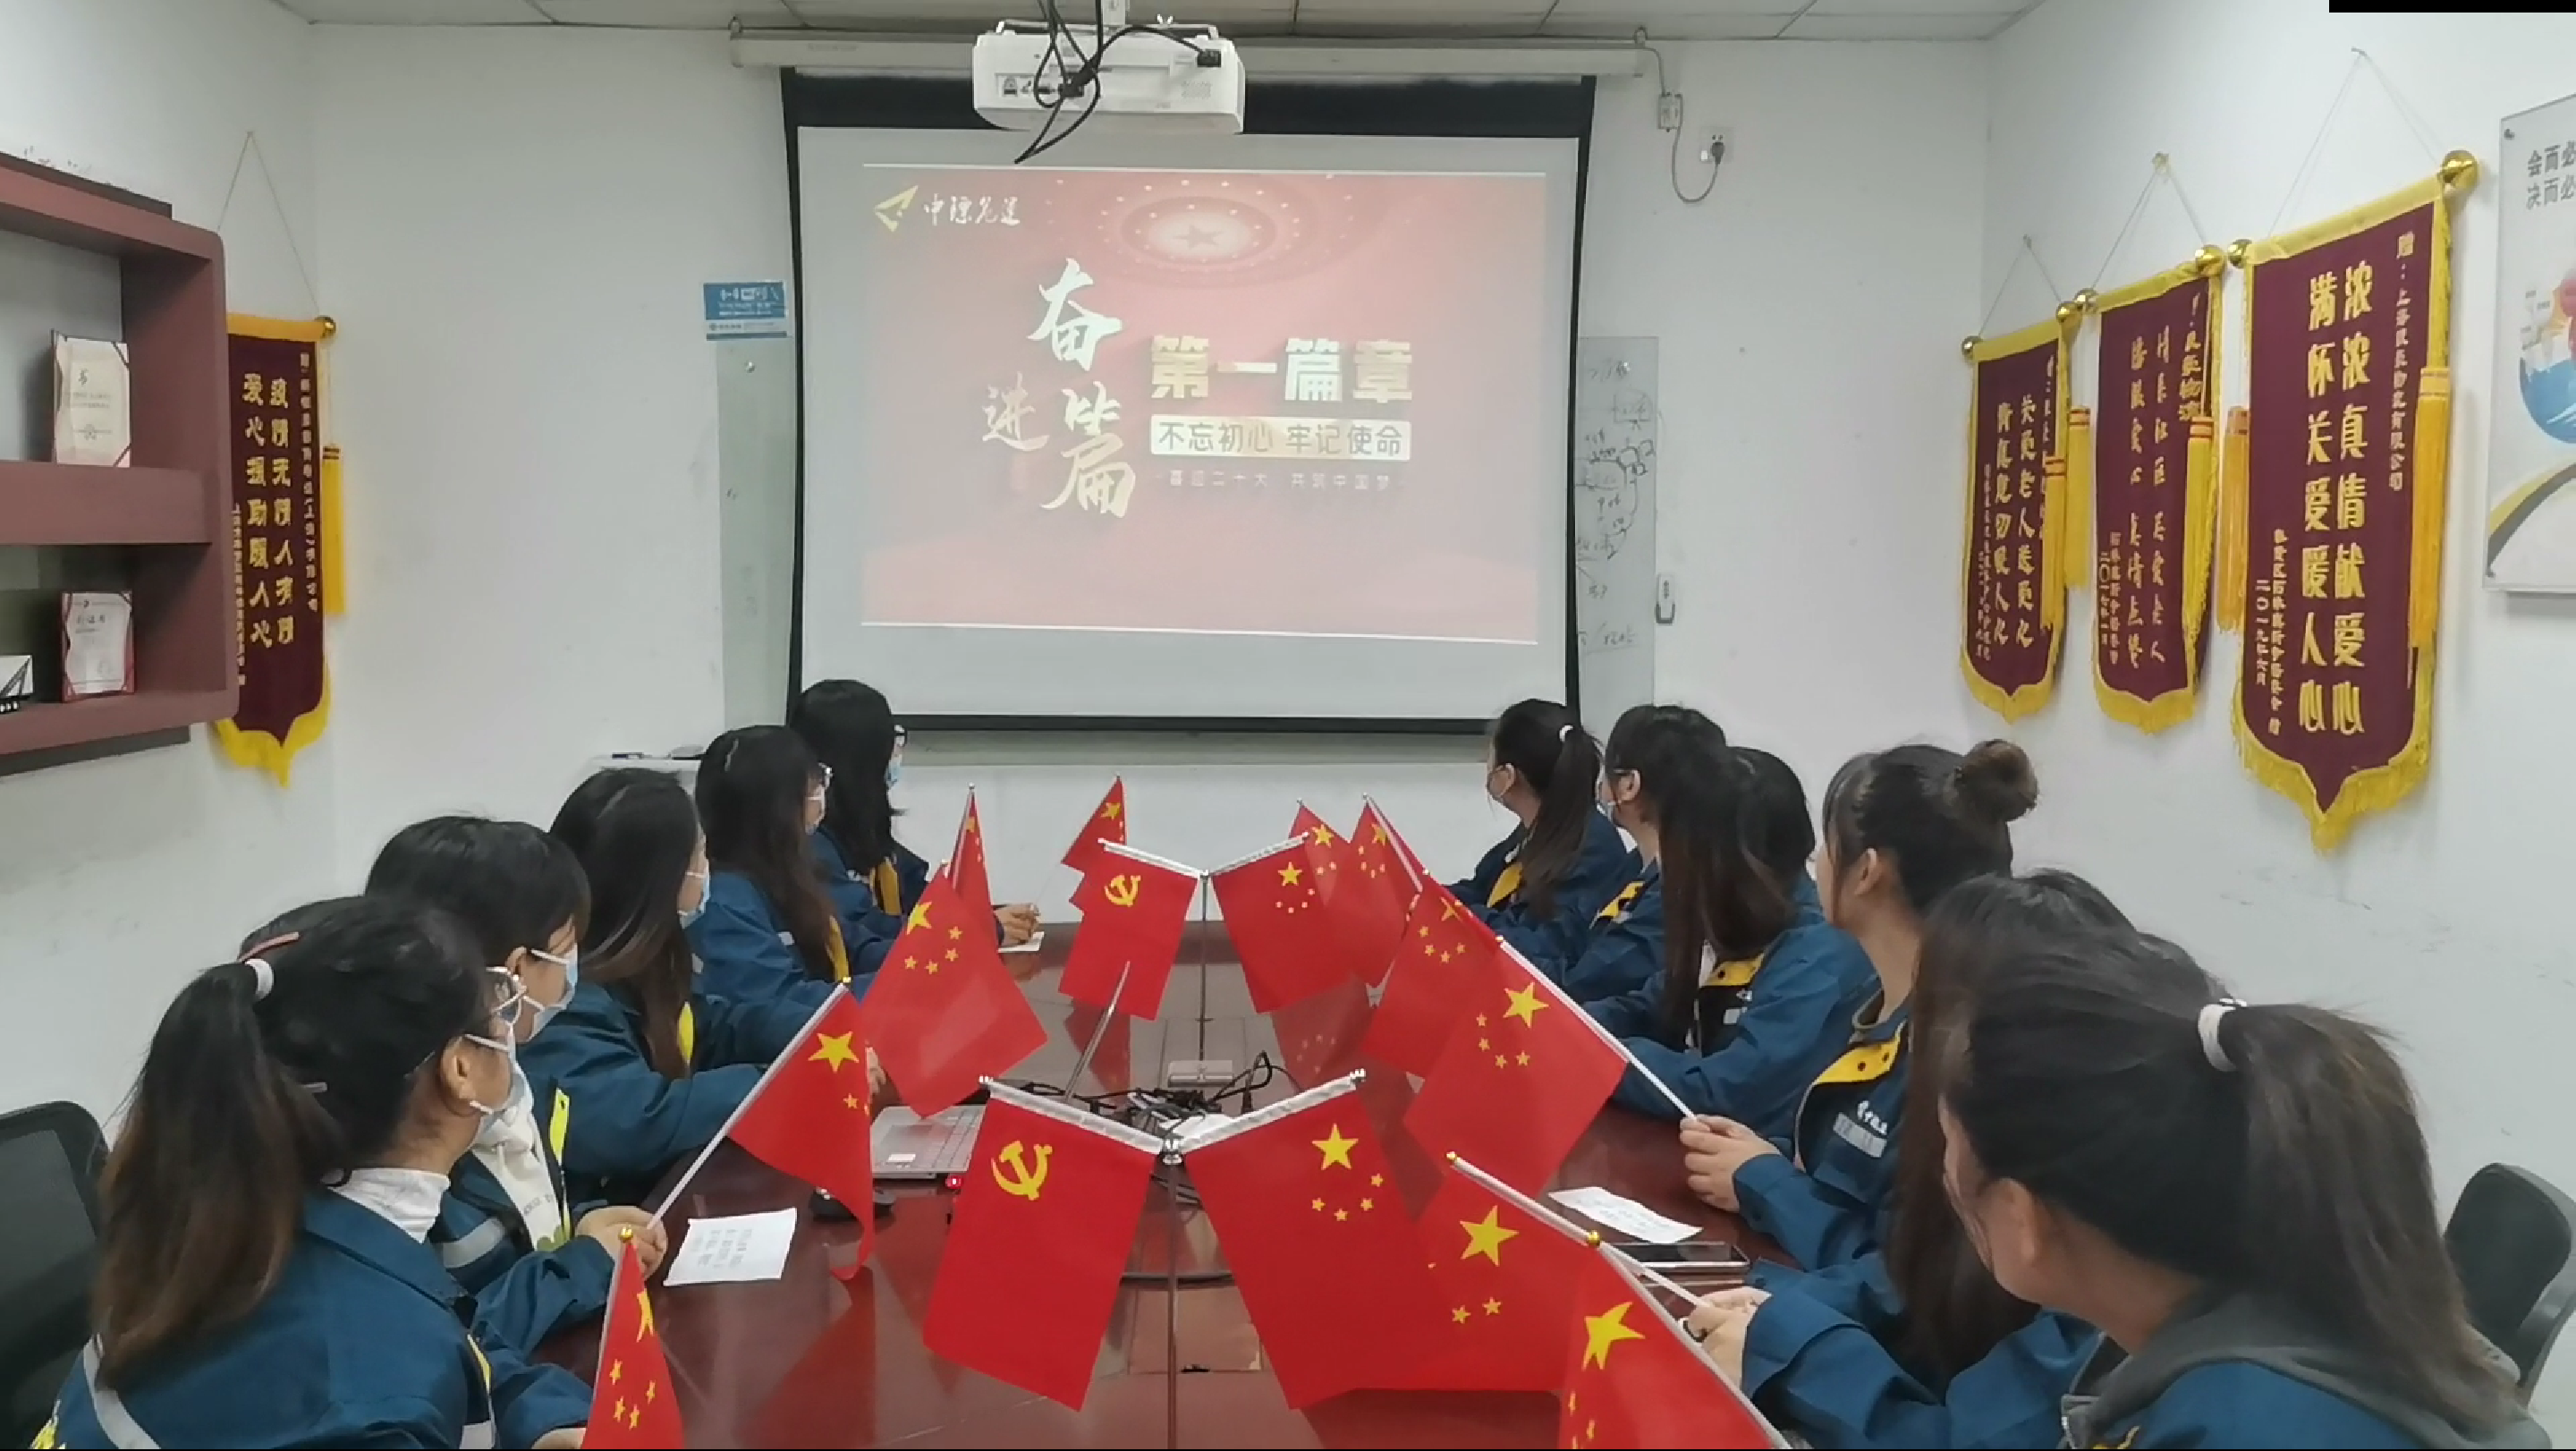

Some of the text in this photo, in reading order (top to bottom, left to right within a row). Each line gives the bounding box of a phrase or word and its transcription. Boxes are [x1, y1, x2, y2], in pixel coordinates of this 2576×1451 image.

[1151, 335, 1412, 403] 第一篇章
[1158, 421, 1402, 457] 不忘初心 牢记使命
[2299, 270, 2338, 734] 满怀关爱暖人心
[2332, 259, 2373, 735] 浓浓真情献爱心
